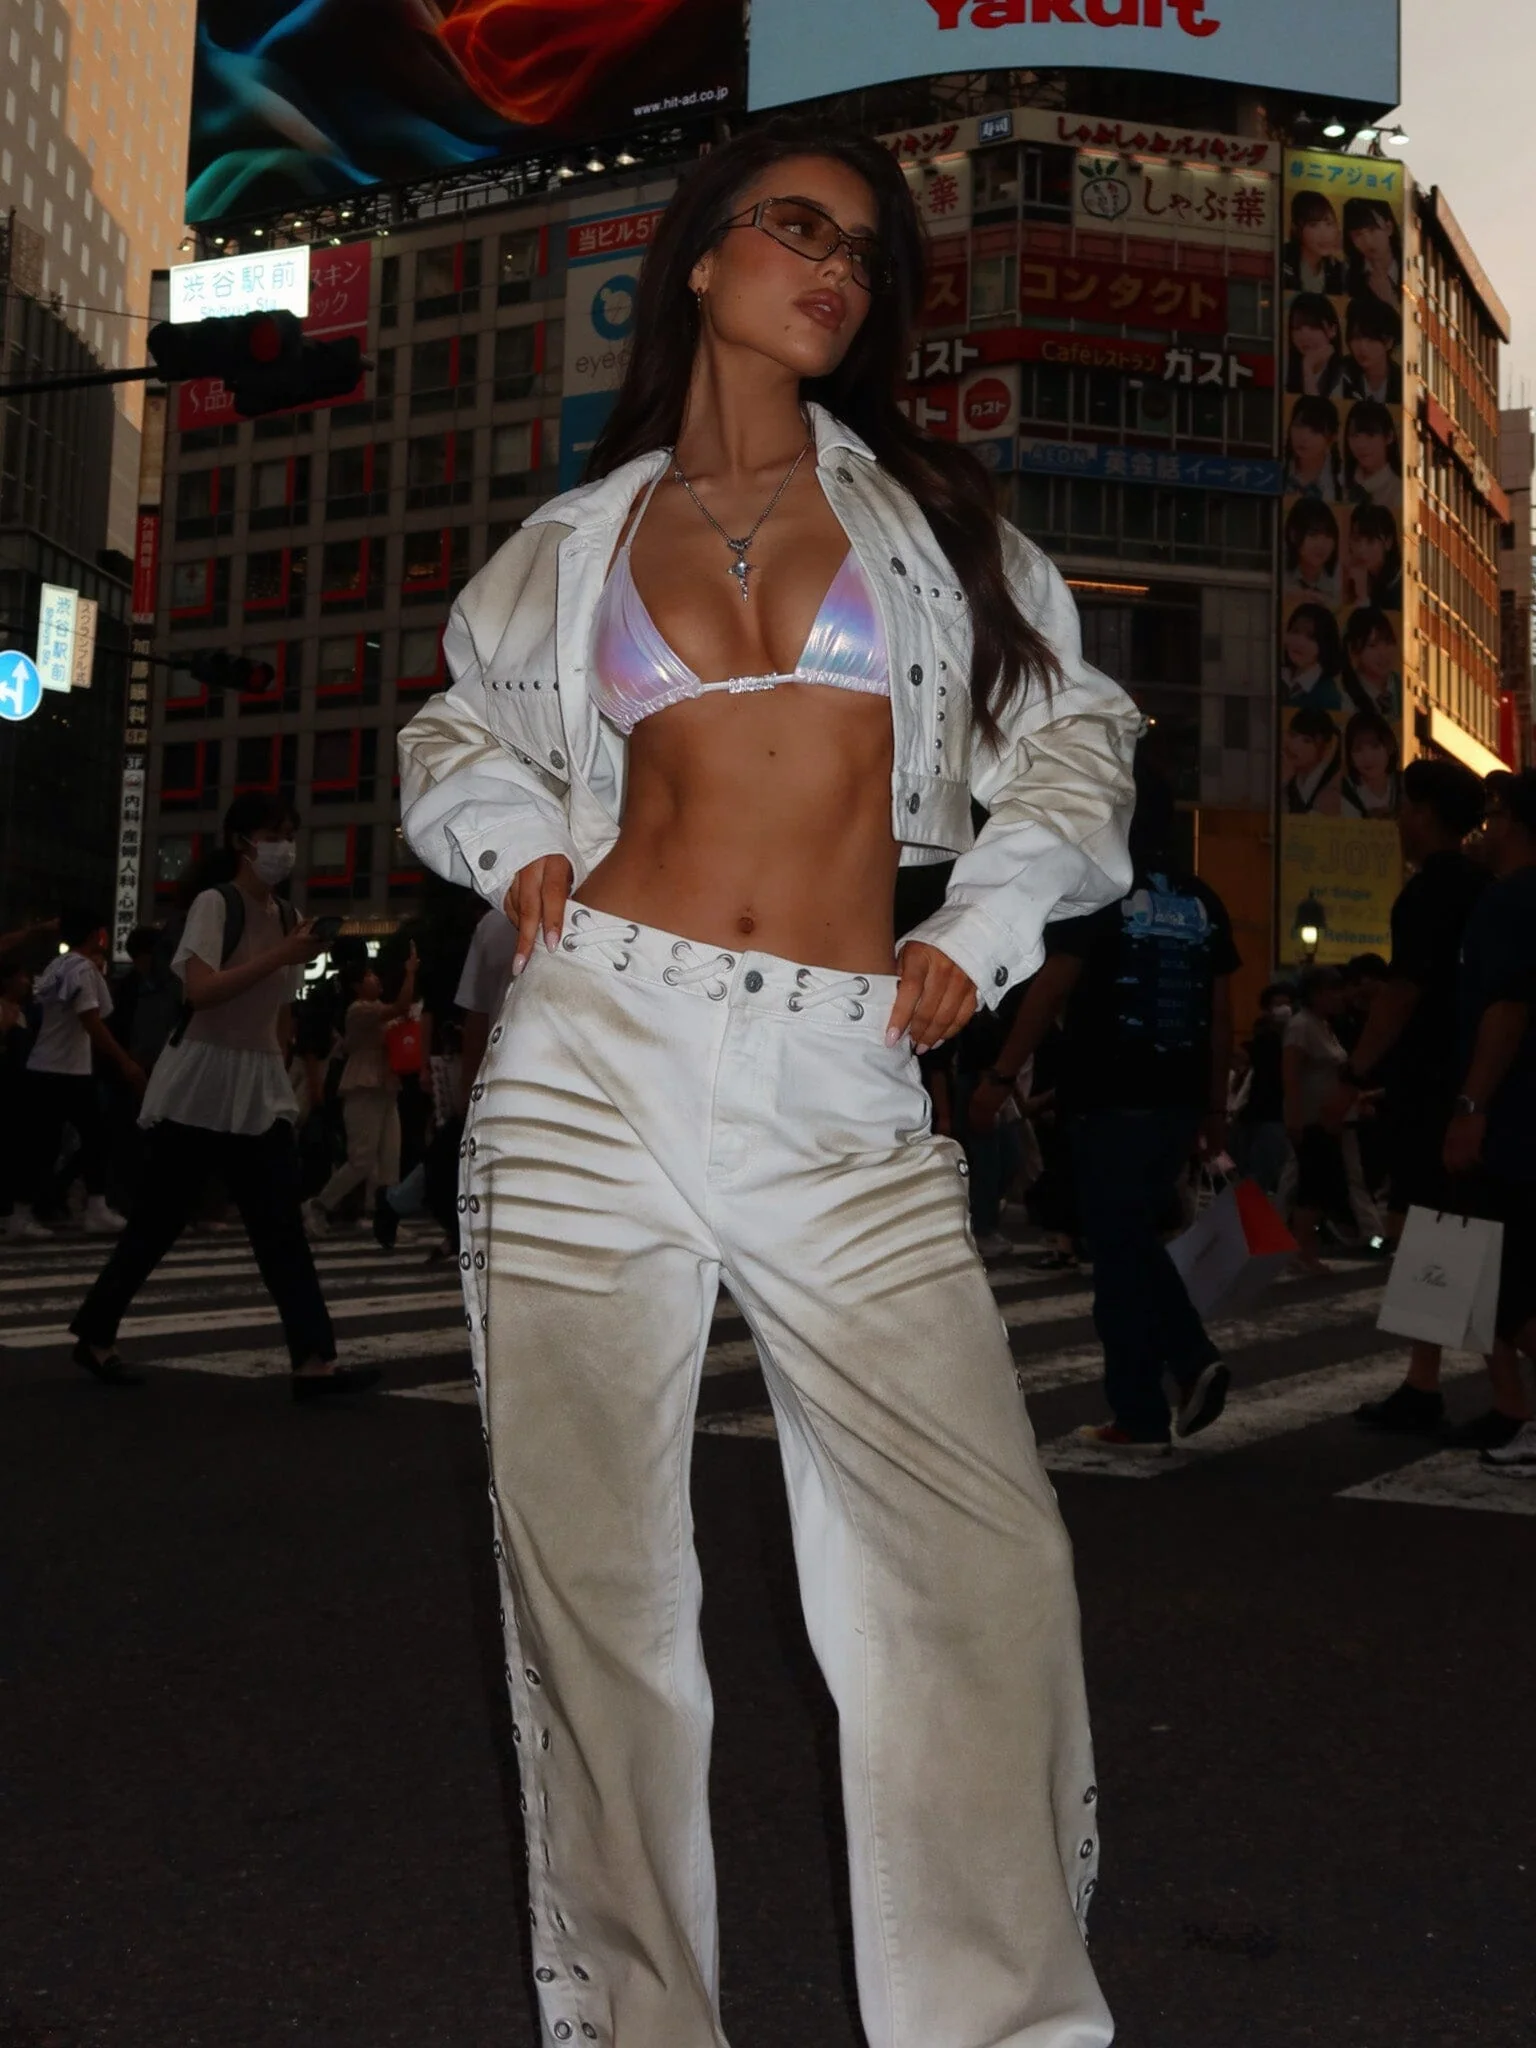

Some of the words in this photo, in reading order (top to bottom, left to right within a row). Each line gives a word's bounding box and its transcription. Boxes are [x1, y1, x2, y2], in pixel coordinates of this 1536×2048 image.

[633, 86, 729, 116] www.hit-ad.co.jp
[1058, 116, 1268, 166] しゃぶしゃぶバイキング
[1144, 175, 1265, 226] しゃぶ葉
[183, 260, 296, 303] 渋谷駅前
[1023, 263, 1218, 320] コンタクト
[311, 290, 349, 318] ック
[1163, 347, 1254, 389] ガスト
[970, 400, 1007, 417] ガスト
